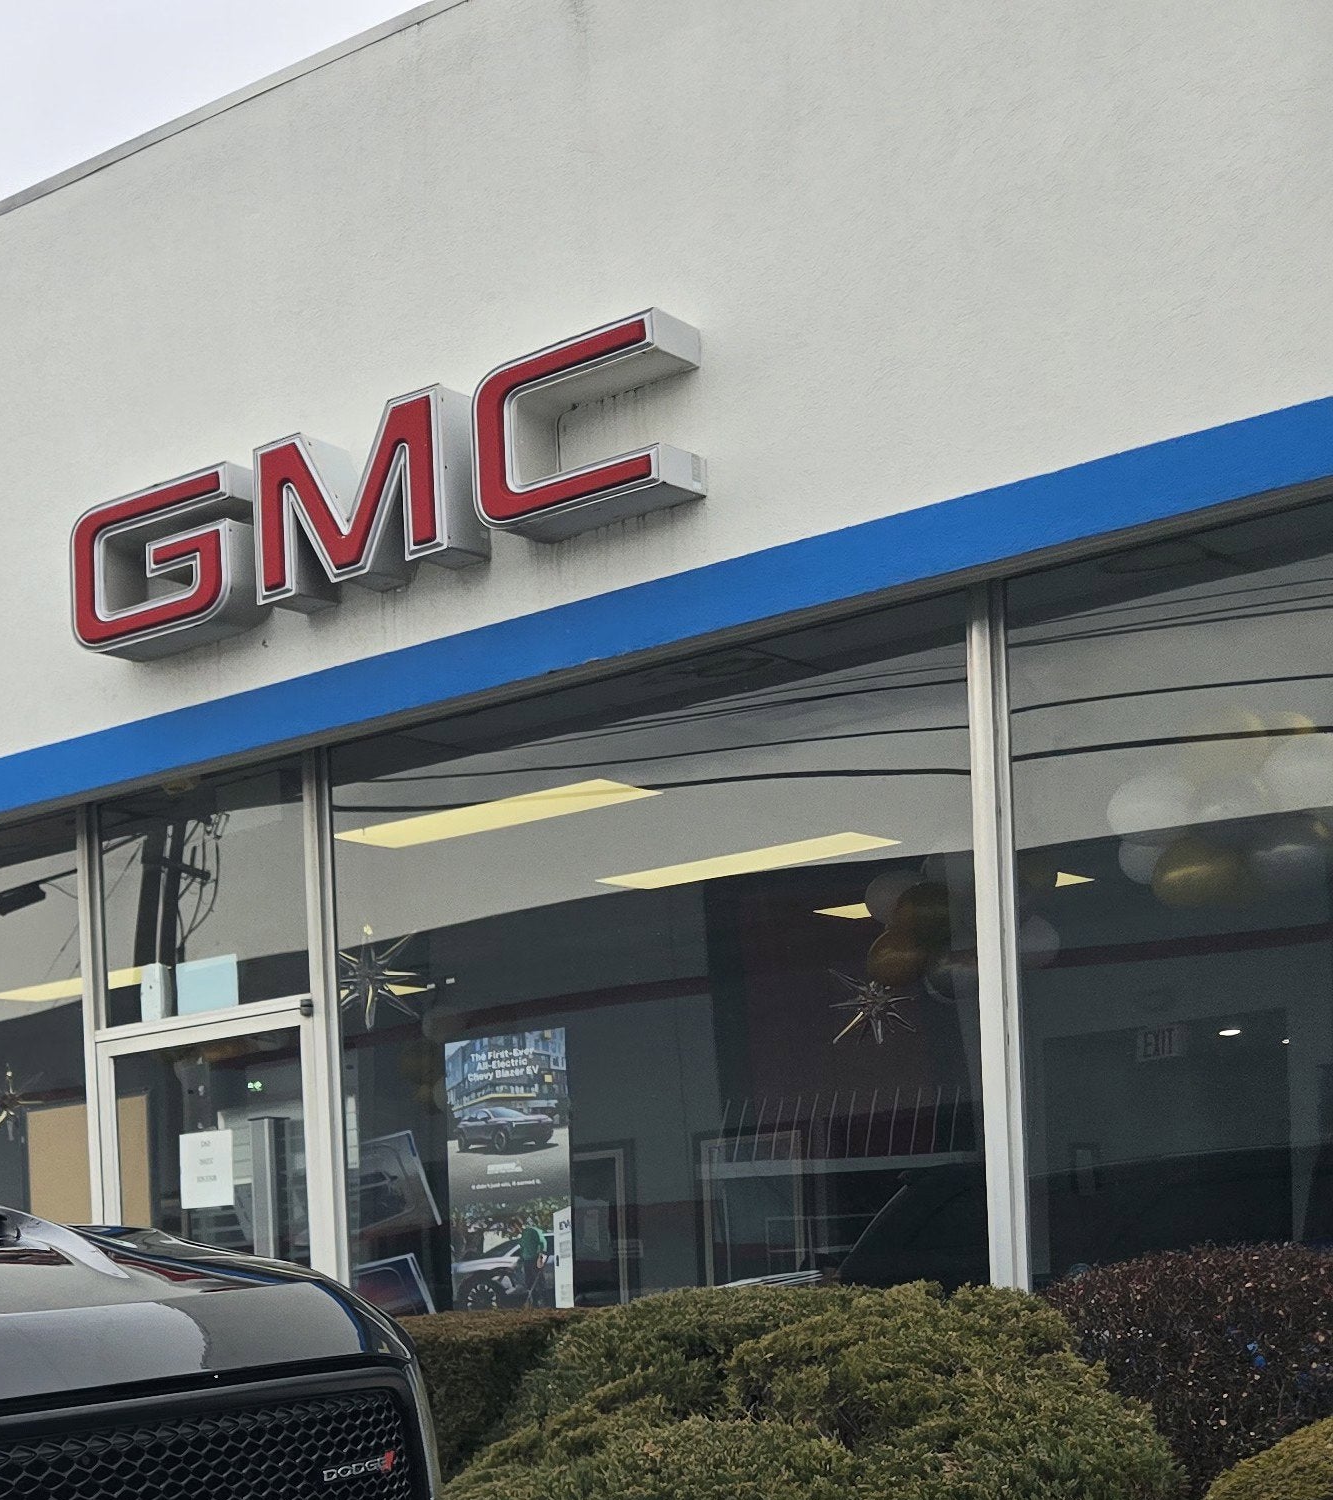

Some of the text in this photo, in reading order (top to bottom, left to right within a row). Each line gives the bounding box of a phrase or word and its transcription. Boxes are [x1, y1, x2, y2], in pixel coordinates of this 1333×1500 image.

[71, 307, 683, 656] GMC
[1143, 1029, 1173, 1058] EXIT
[470, 1053, 486, 1062] The
[467, 1064, 540, 1083] Chevy Blazer EV
[323, 1457, 386, 1481] DODGE
